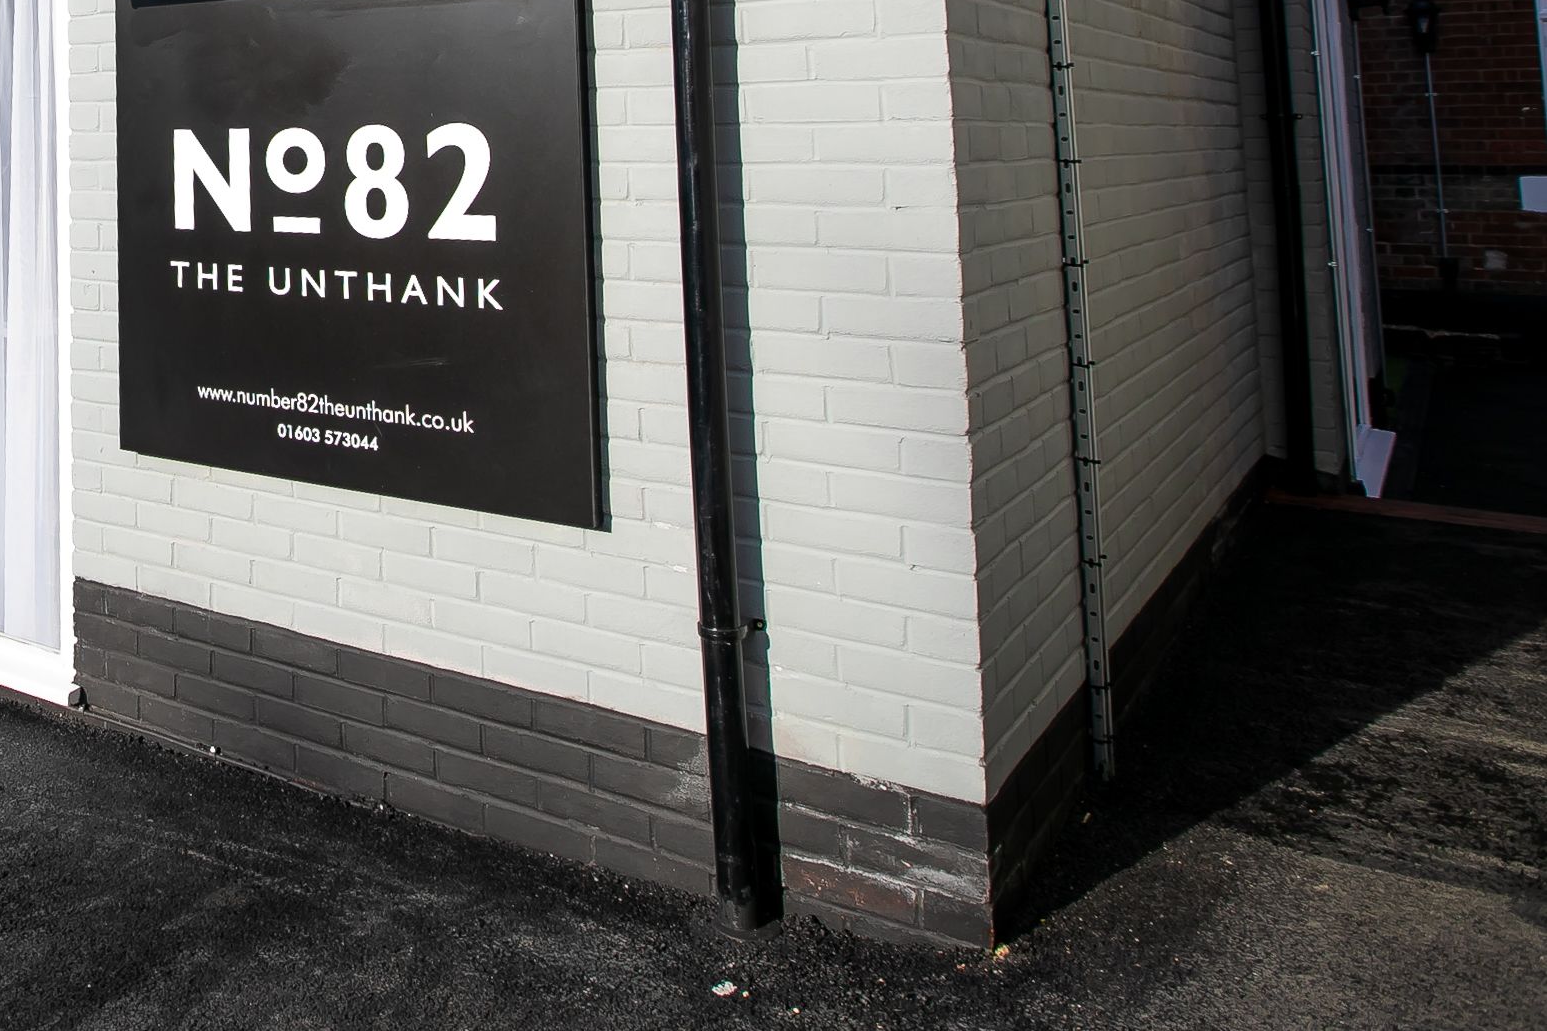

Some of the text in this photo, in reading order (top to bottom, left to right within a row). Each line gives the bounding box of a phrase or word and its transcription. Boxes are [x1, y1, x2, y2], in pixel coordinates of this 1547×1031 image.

[169, 259, 505, 312] THE UNTHANK
[196, 384, 476, 435] www.number82theunthank.co.uk
[276, 422, 379, 452] 01603 573044
